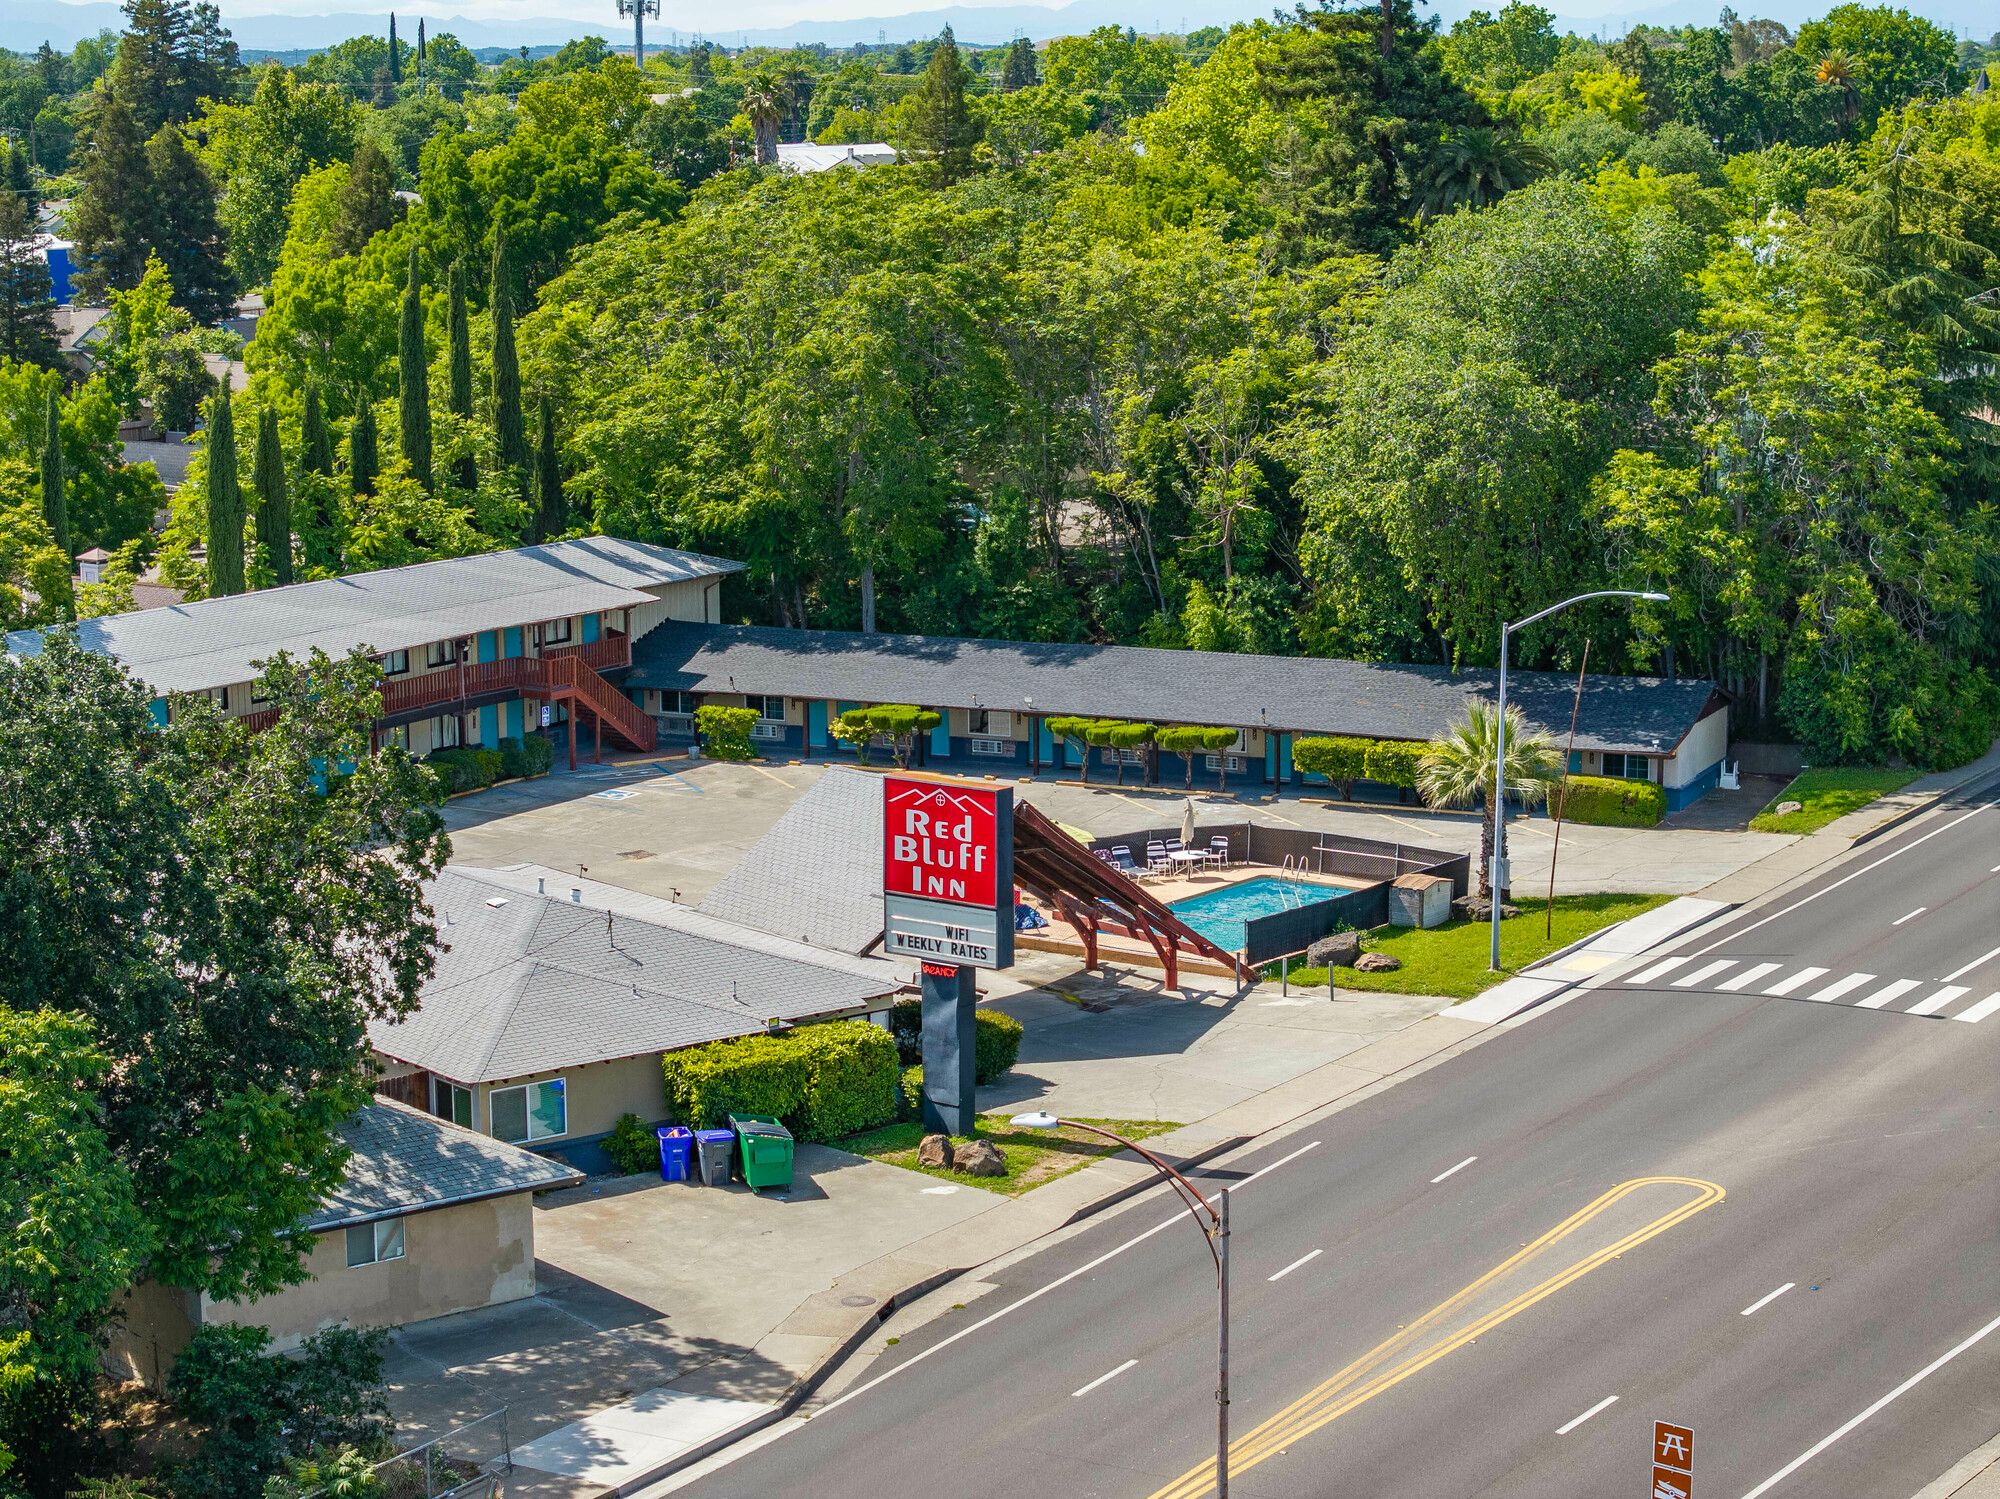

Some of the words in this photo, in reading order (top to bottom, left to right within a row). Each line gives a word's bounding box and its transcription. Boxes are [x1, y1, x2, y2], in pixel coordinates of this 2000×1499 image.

[894, 835, 987, 873] Bluff
[896, 933, 942, 953] WEEKLY
[951, 942, 987, 960] RATES
[945, 925, 969, 942] WIFI
